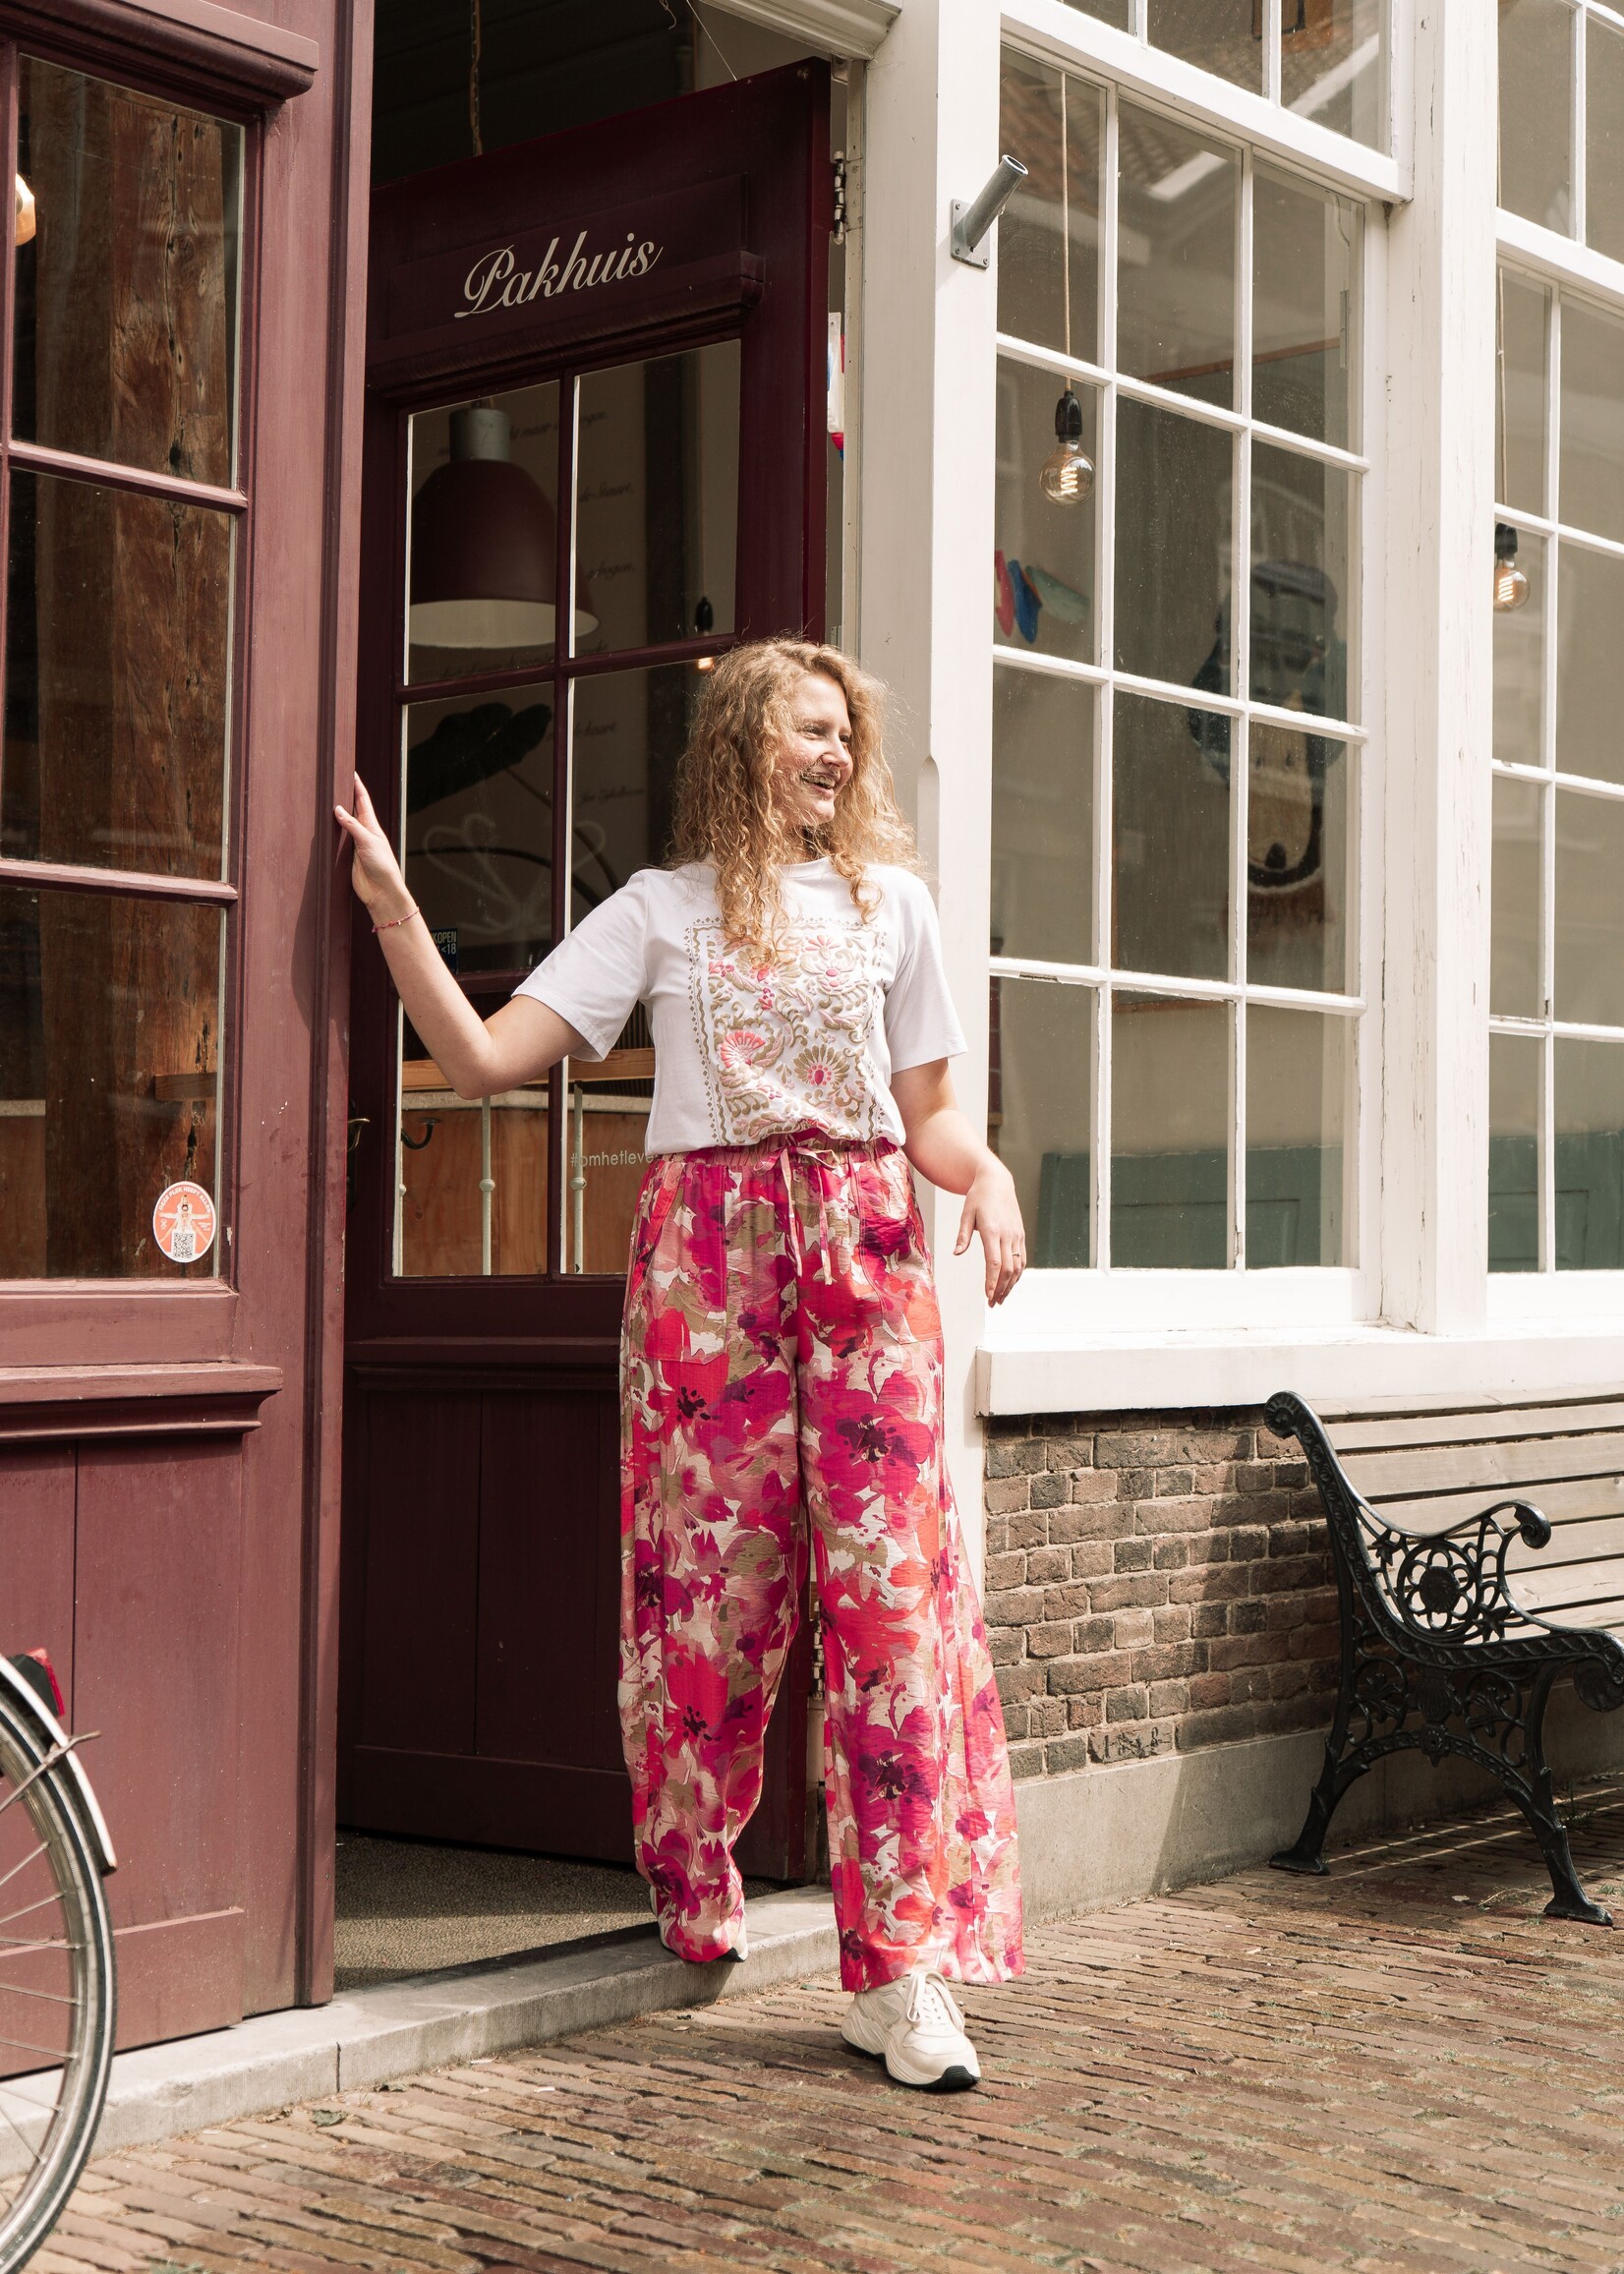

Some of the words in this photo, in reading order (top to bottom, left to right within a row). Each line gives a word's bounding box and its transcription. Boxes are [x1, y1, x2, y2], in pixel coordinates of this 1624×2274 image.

[453, 230, 664, 319] Pakhuis
[440, 943, 457, 956] <18
[570, 1150, 657, 1168] #omhetleve
[169, 1187, 184, 1197] PLEK
[183, 1187, 200, 1196] HEEFT
